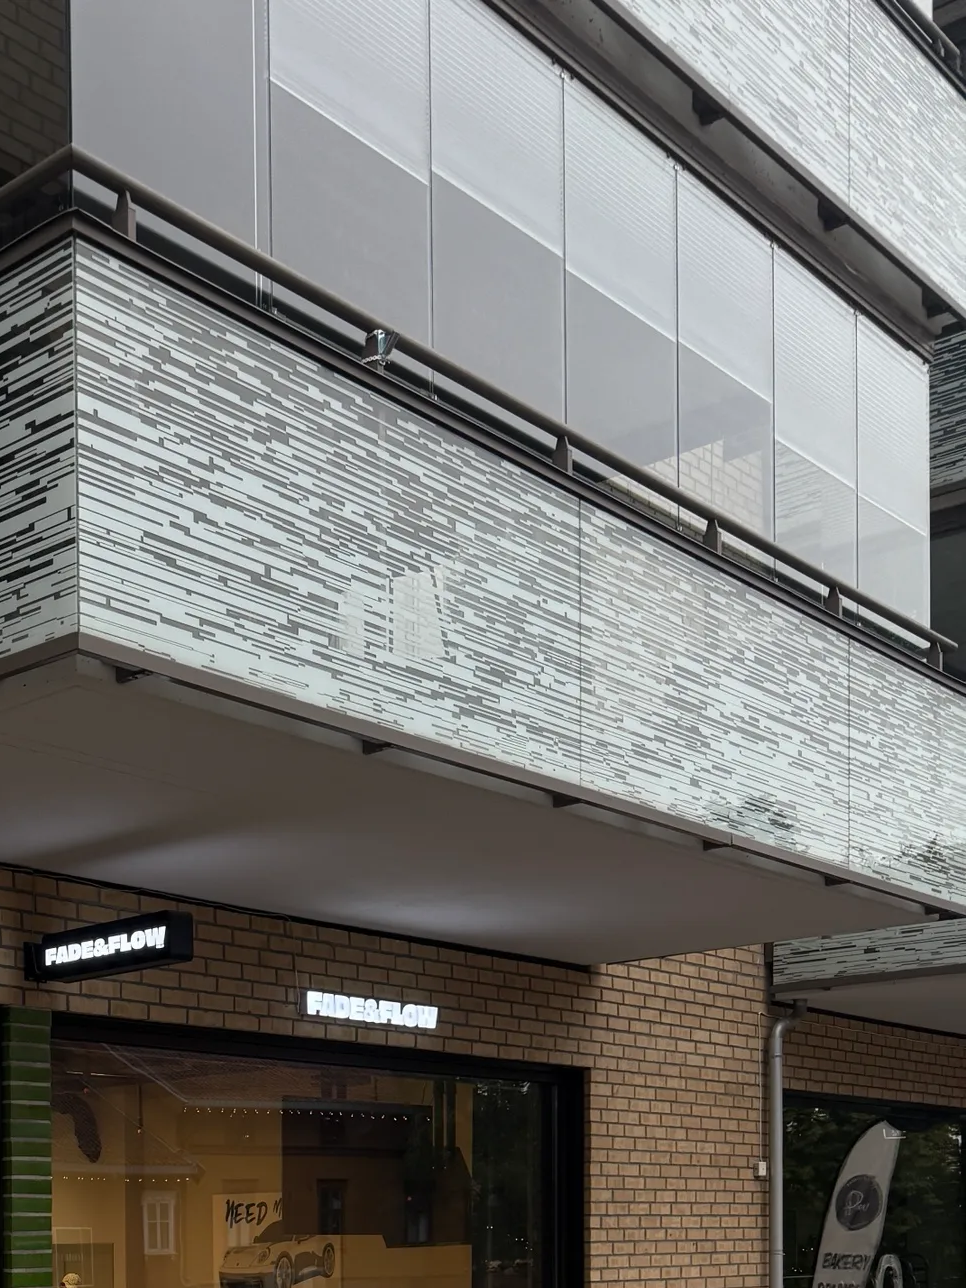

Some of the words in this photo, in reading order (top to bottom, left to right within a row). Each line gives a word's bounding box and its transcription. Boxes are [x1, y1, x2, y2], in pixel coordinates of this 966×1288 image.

[45, 926, 167, 966] FADE&FLOW
[307, 990, 439, 1029] FADE&FLOW
[225, 1199, 268, 1229] NEED
[822, 1252, 871, 1271] BAKERY
